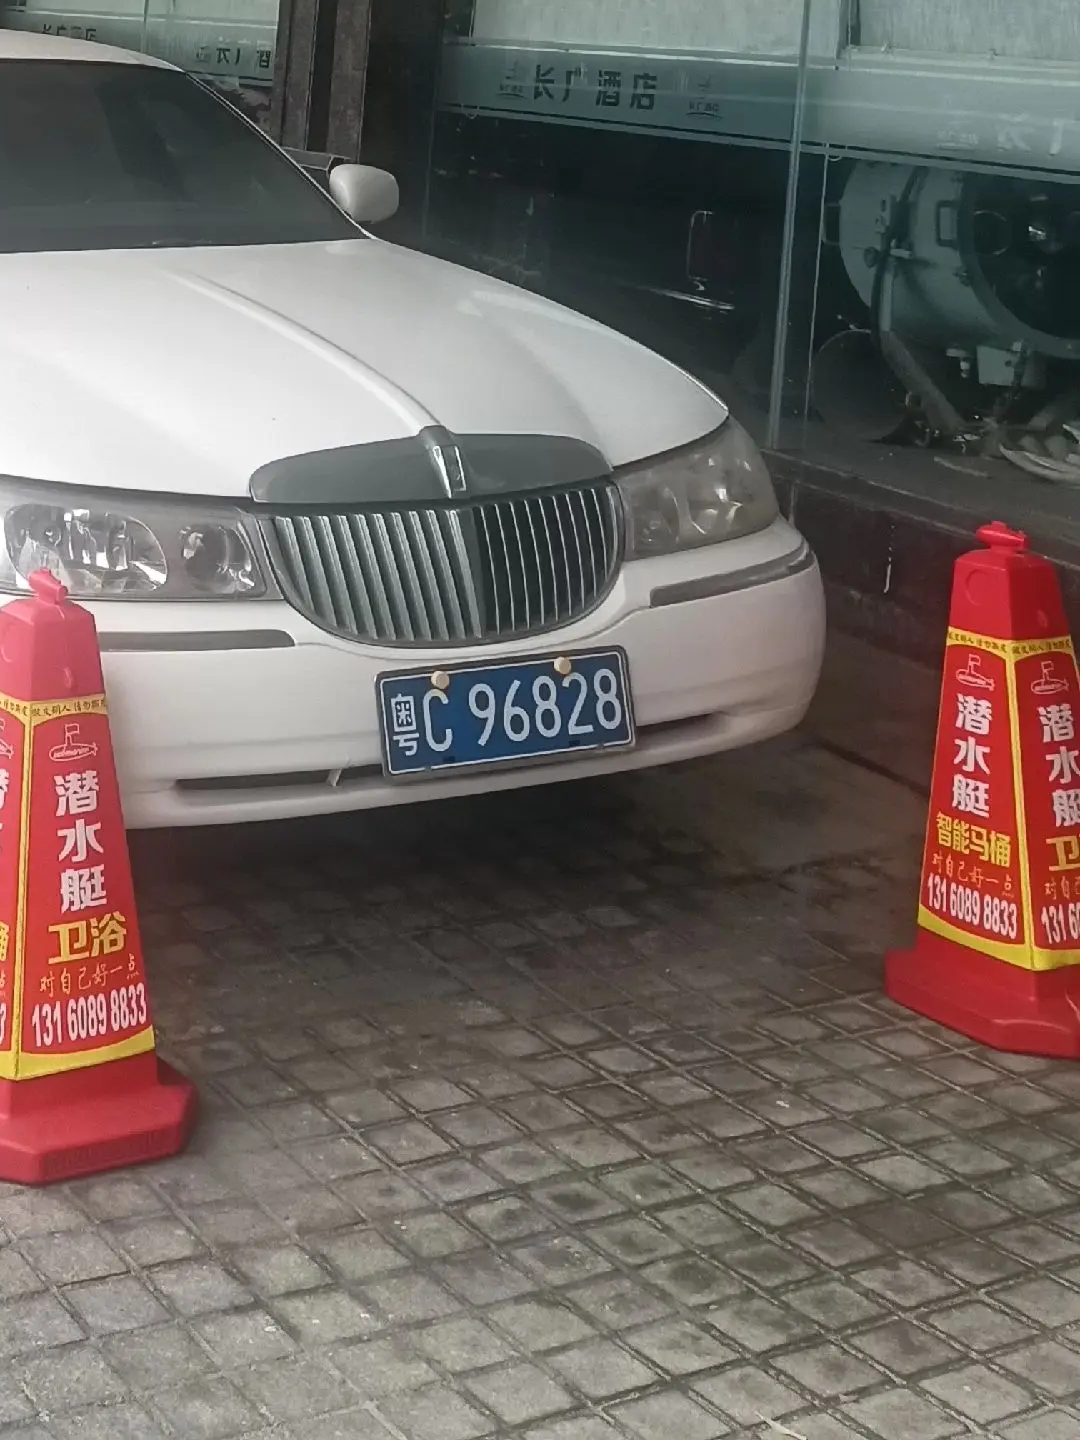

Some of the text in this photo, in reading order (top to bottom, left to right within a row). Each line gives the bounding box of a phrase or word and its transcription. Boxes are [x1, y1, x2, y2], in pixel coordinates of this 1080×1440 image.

[533, 64, 658, 110] 长广酒店
[952, 692, 993, 818] 潜水艇
[53, 770, 107, 914] 潜水艇
[935, 810, 1012, 868] 智能马桶
[931, 849, 1015, 899] 对自己好一点
[927, 872, 1018, 940] 131 6089 8833
[48, 911, 127, 965] 卫浴
[39, 953, 139, 998] 对自己好一点
[32, 982, 148, 1048] 131 6089 8833
